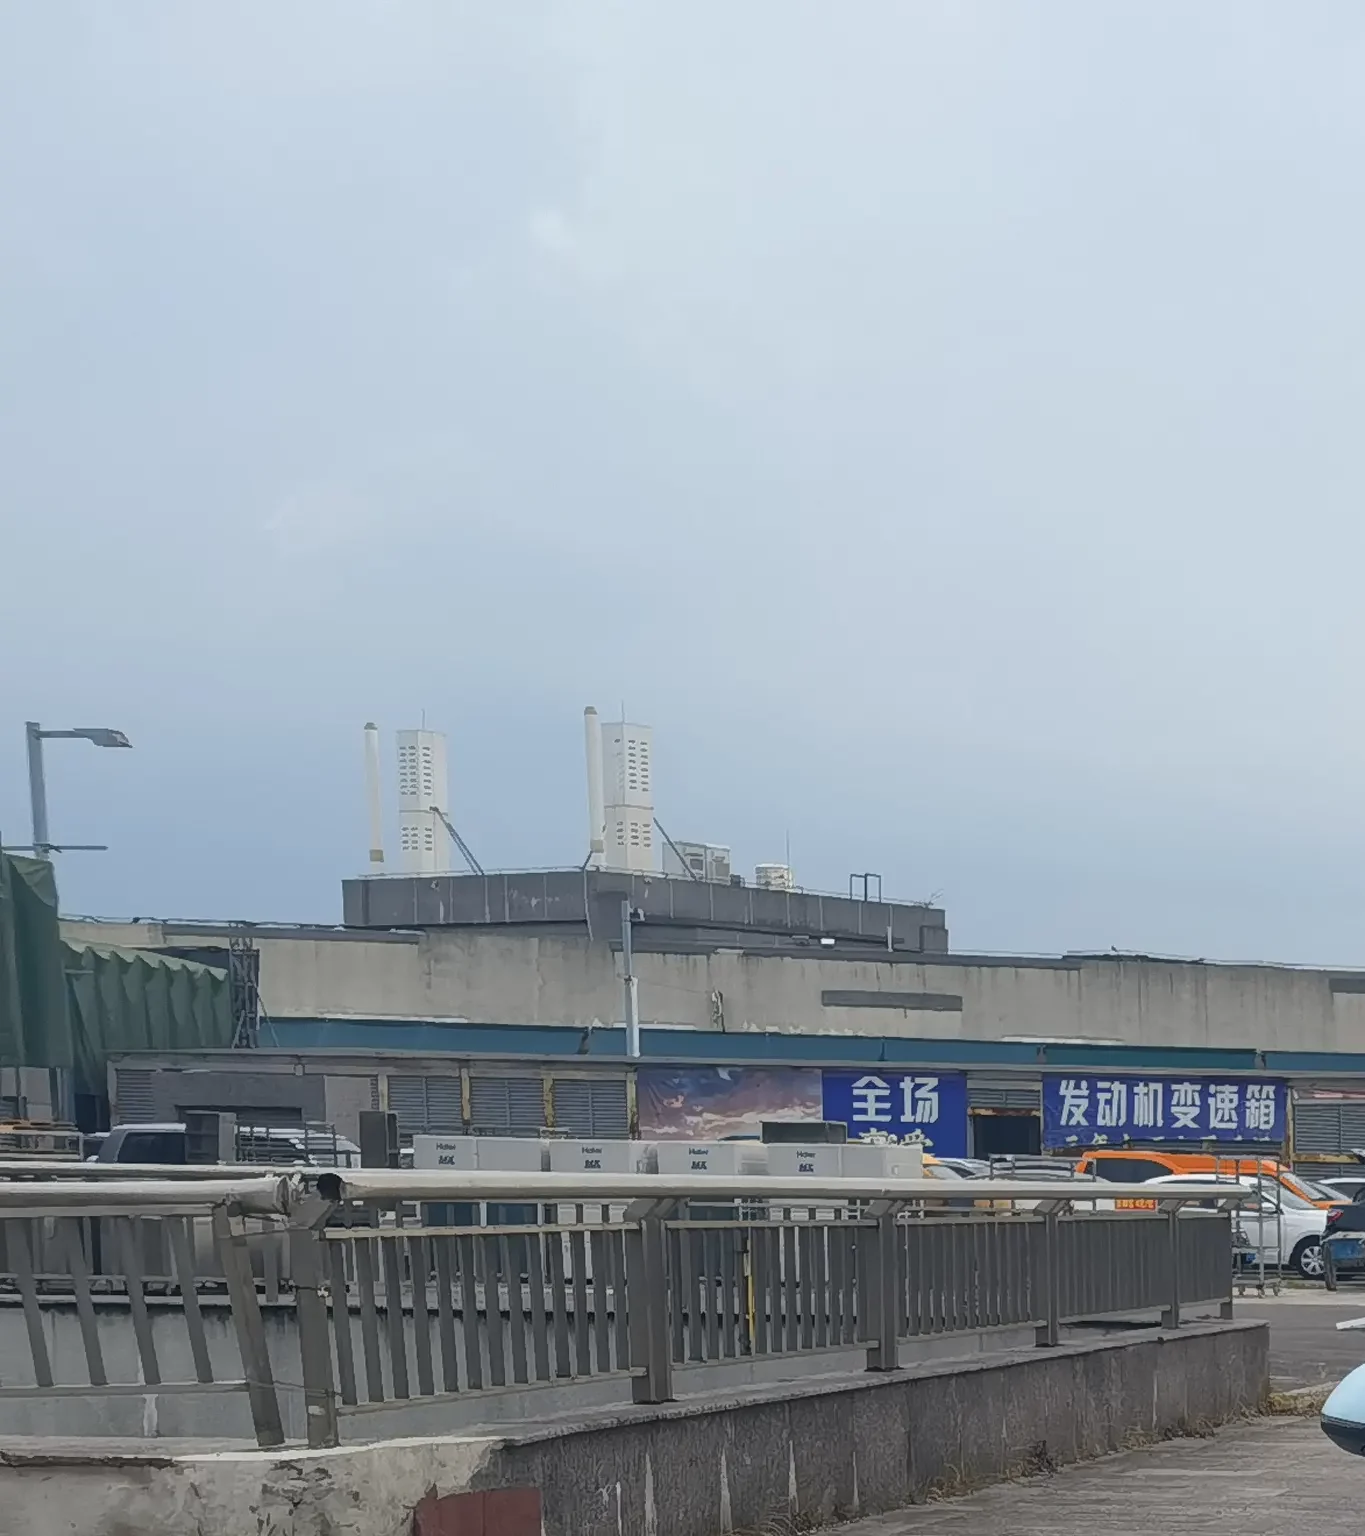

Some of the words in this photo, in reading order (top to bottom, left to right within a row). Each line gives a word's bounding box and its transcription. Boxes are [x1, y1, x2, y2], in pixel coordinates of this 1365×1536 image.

[851, 1076, 939, 1123] 全场
[1058, 1079, 1277, 1130] 发动机变速箱
